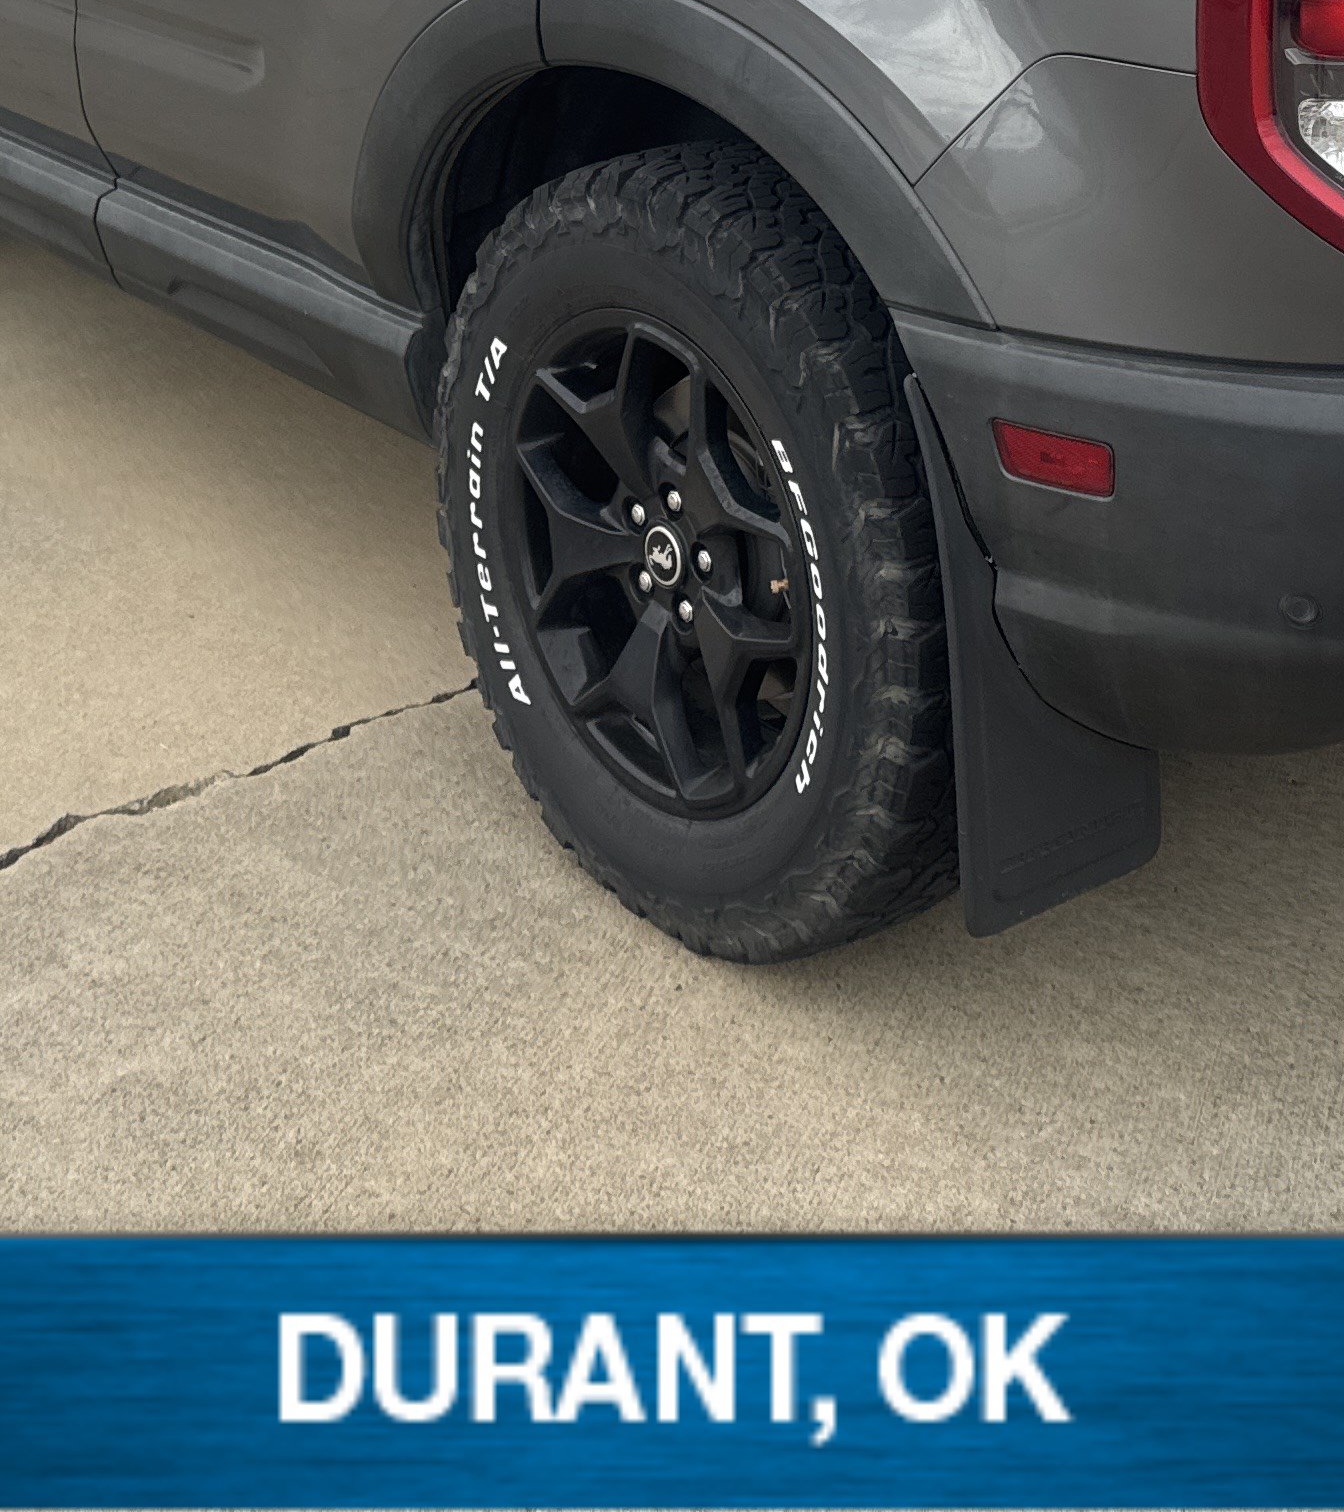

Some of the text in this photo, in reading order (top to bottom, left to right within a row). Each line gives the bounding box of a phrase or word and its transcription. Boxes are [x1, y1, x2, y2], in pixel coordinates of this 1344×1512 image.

[465, 335, 532, 707] All-Terrain T/A
[770, 438, 830, 795] BFGoodrich
